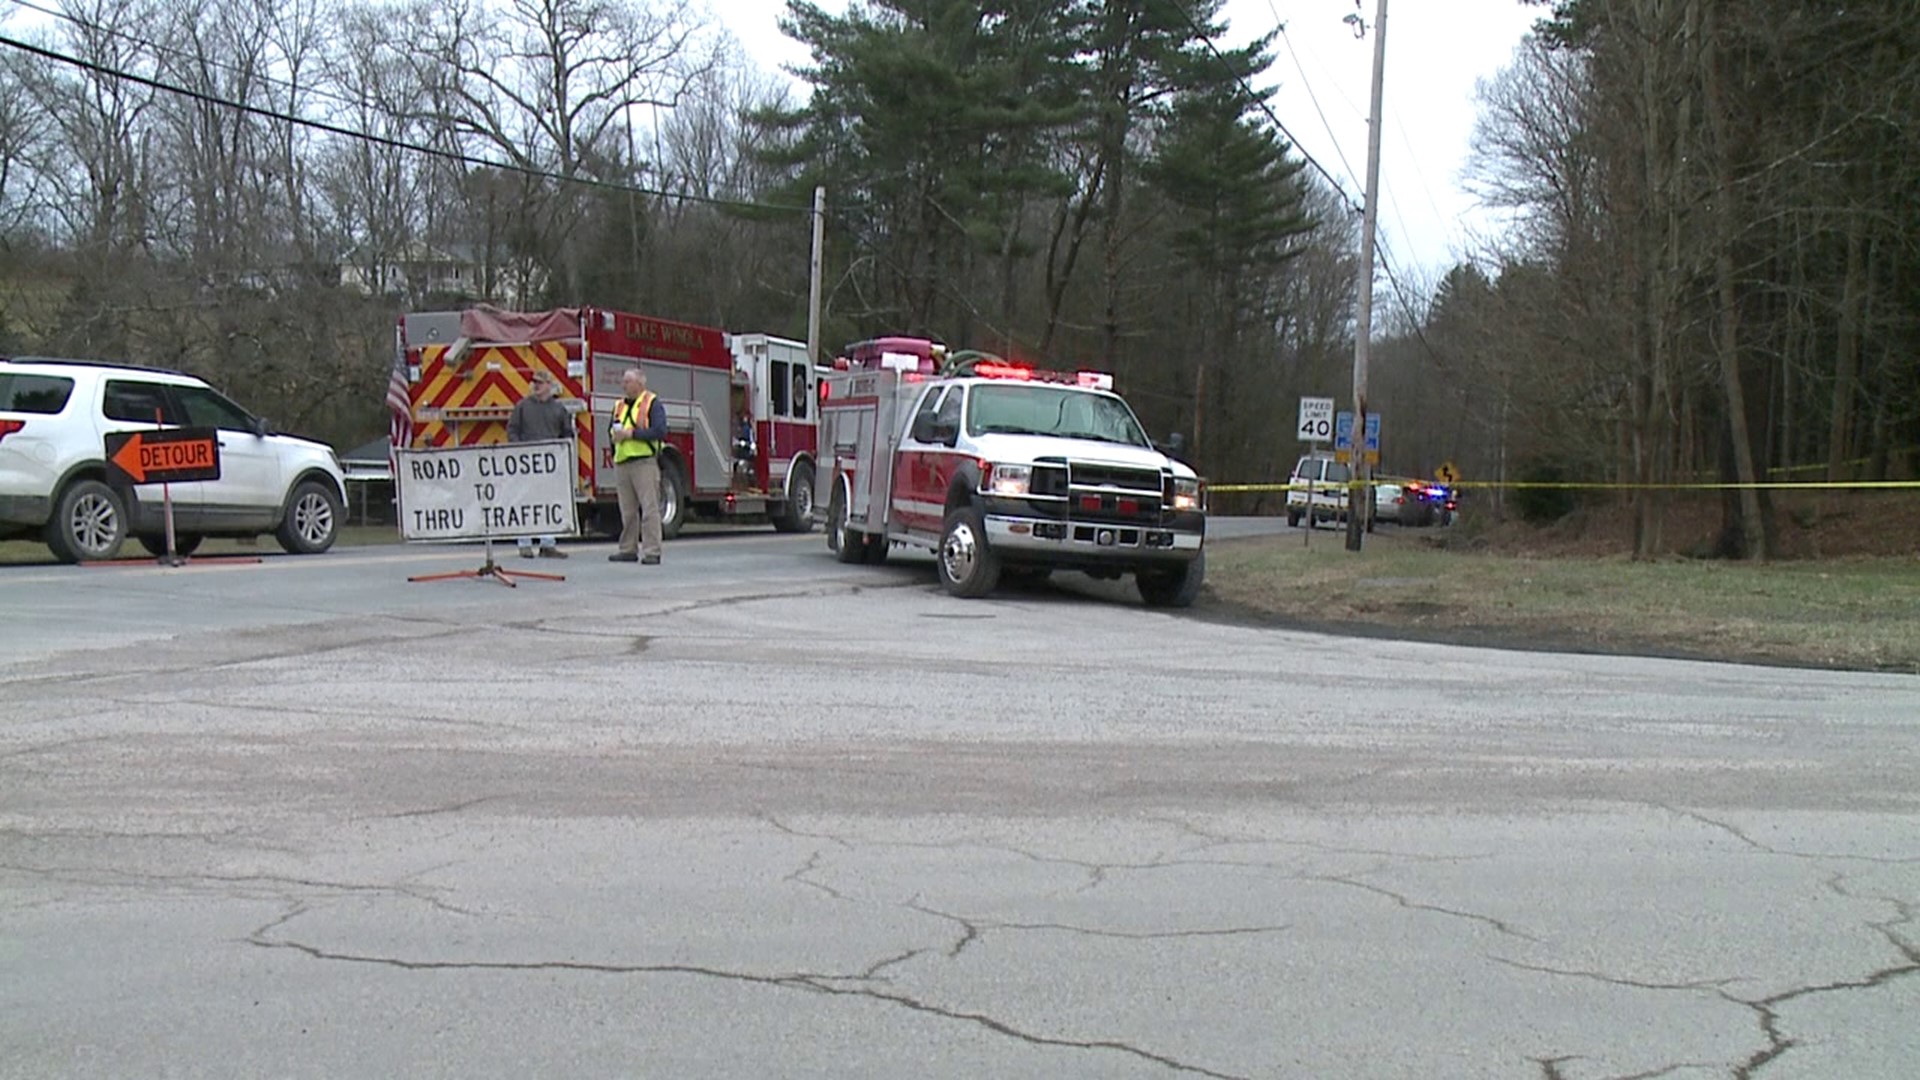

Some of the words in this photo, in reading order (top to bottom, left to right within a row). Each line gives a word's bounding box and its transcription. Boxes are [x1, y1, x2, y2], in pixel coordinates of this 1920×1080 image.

[625, 319, 657, 340] LAKE
[1303, 402, 1331, 410] SPEED
[1301, 420, 1329, 436] 40
[140, 443, 208, 467] DETOUR
[412, 458, 460, 480] ROAD
[478, 453, 556, 477] CLOSED
[474, 483, 495, 501] TO
[414, 508, 463, 530] THRU
[482, 504, 563, 528] TRAFFIC
